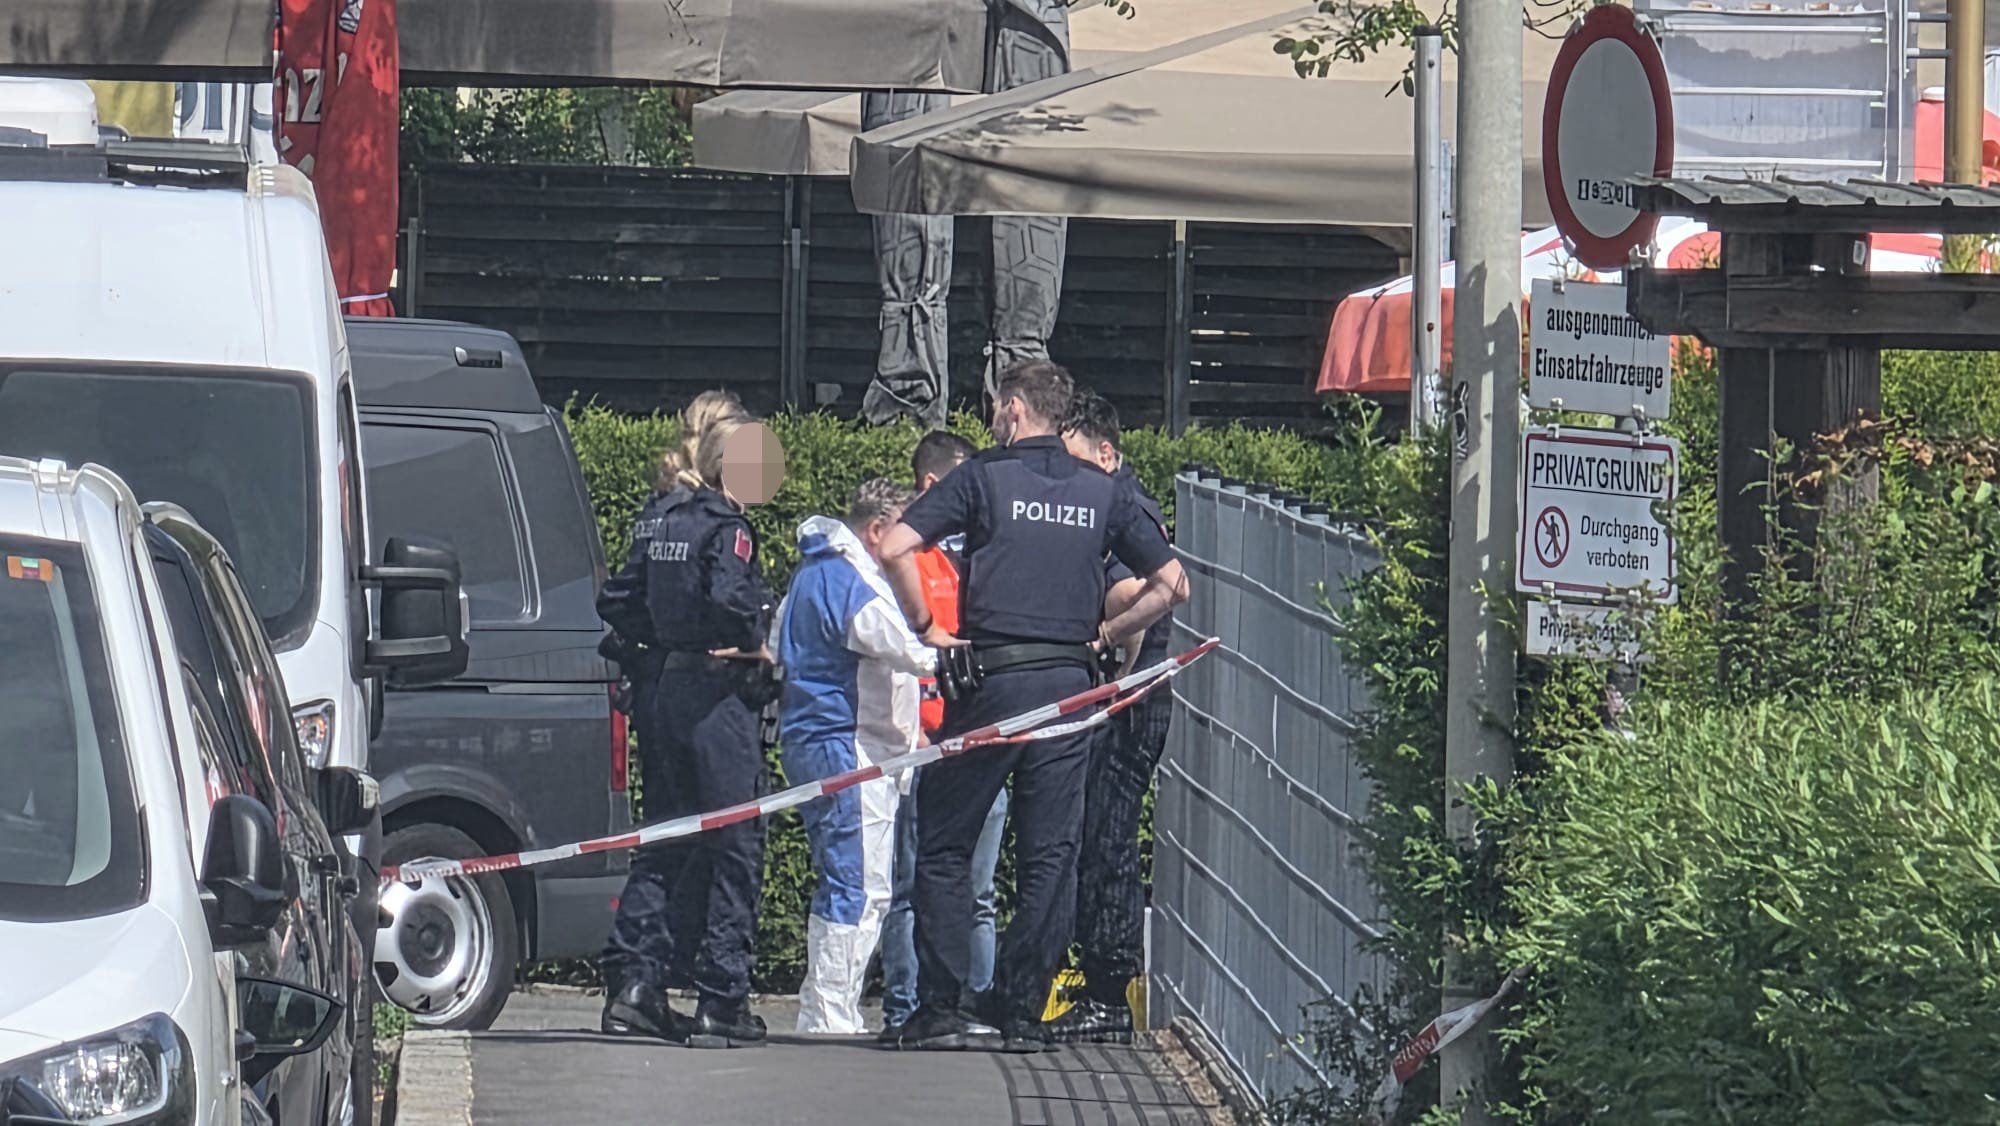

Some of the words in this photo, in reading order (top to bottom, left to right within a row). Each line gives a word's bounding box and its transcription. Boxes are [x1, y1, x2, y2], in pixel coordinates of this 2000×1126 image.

[1535, 348, 1664, 395] Einsatzfahrzeuge
[1532, 452, 1664, 494] PRIVATGRUND
[1012, 500, 1095, 529] POLIZEI
[1580, 515, 1659, 547] Durchgang
[1586, 548, 1650, 571] verboten
